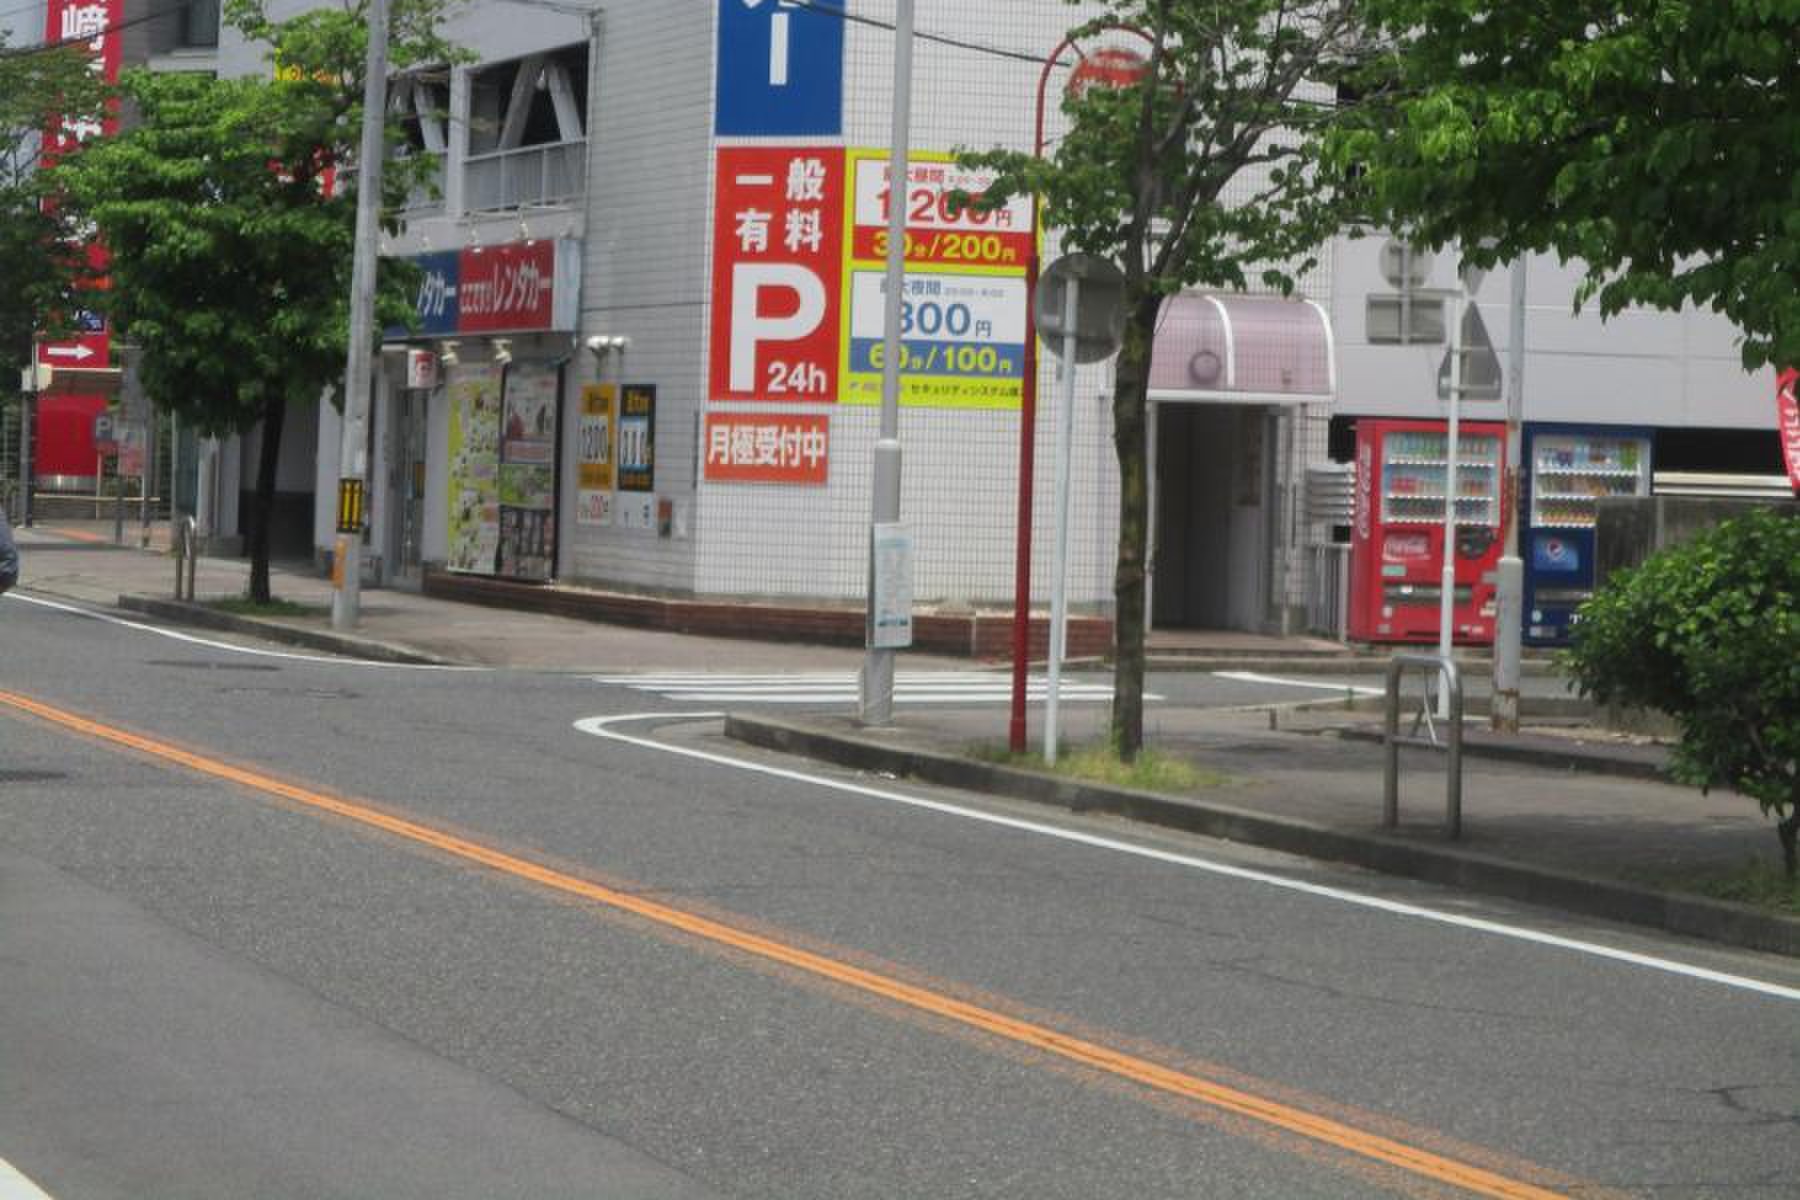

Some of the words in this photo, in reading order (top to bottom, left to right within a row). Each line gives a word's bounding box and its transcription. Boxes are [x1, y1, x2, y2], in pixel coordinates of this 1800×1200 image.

[729, 262, 828, 393] P
[767, 361, 828, 394] 24h
[707, 424, 828, 468] 月極受付中
